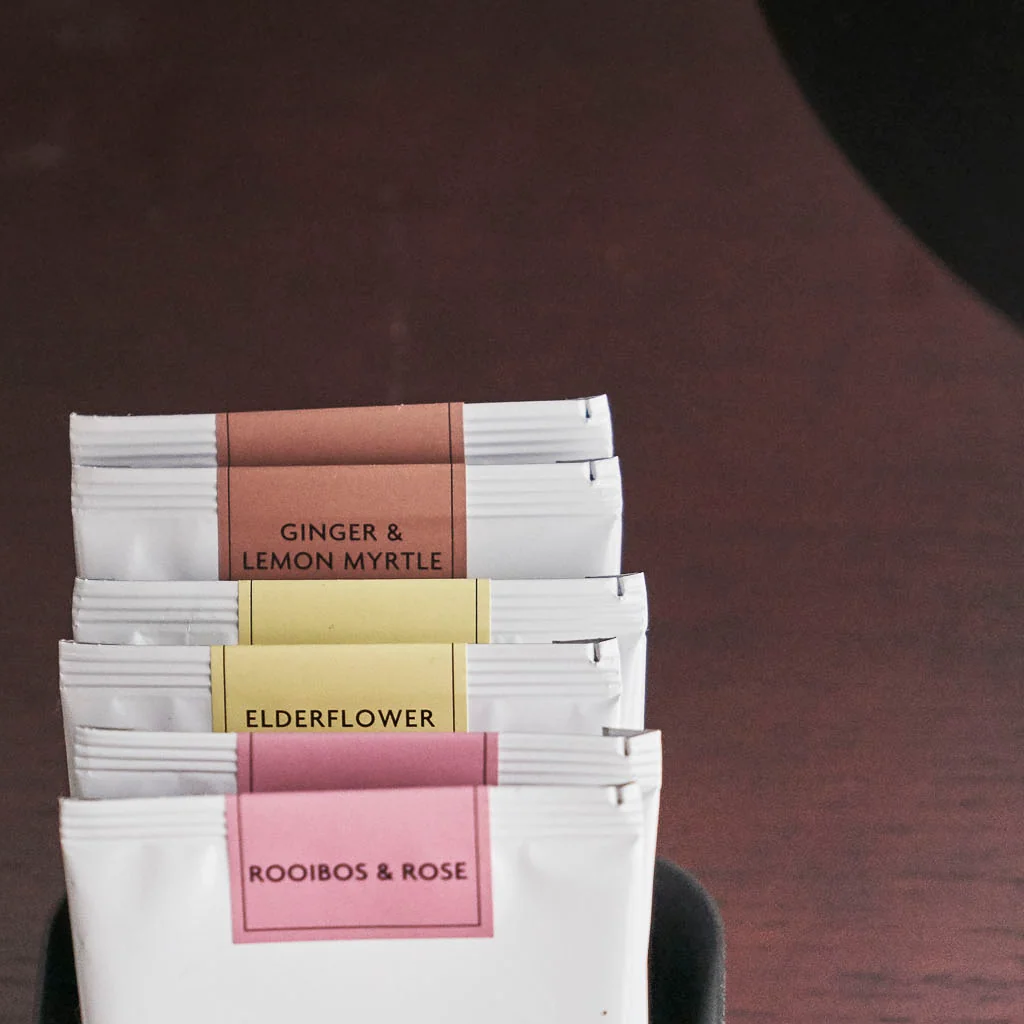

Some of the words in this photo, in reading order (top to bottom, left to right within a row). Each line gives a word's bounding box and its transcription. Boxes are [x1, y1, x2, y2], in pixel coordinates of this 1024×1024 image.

[280, 523, 377, 541] GINGER
[387, 523, 403, 541] &
[242, 551, 333, 571] LEMON
[344, 551, 443, 571] MYRTLE
[246, 709, 435, 728] ELDERFLOWER
[249, 863, 368, 883] ROOIBOS
[377, 863, 393, 882] &
[401, 862, 468, 881] ROSE
